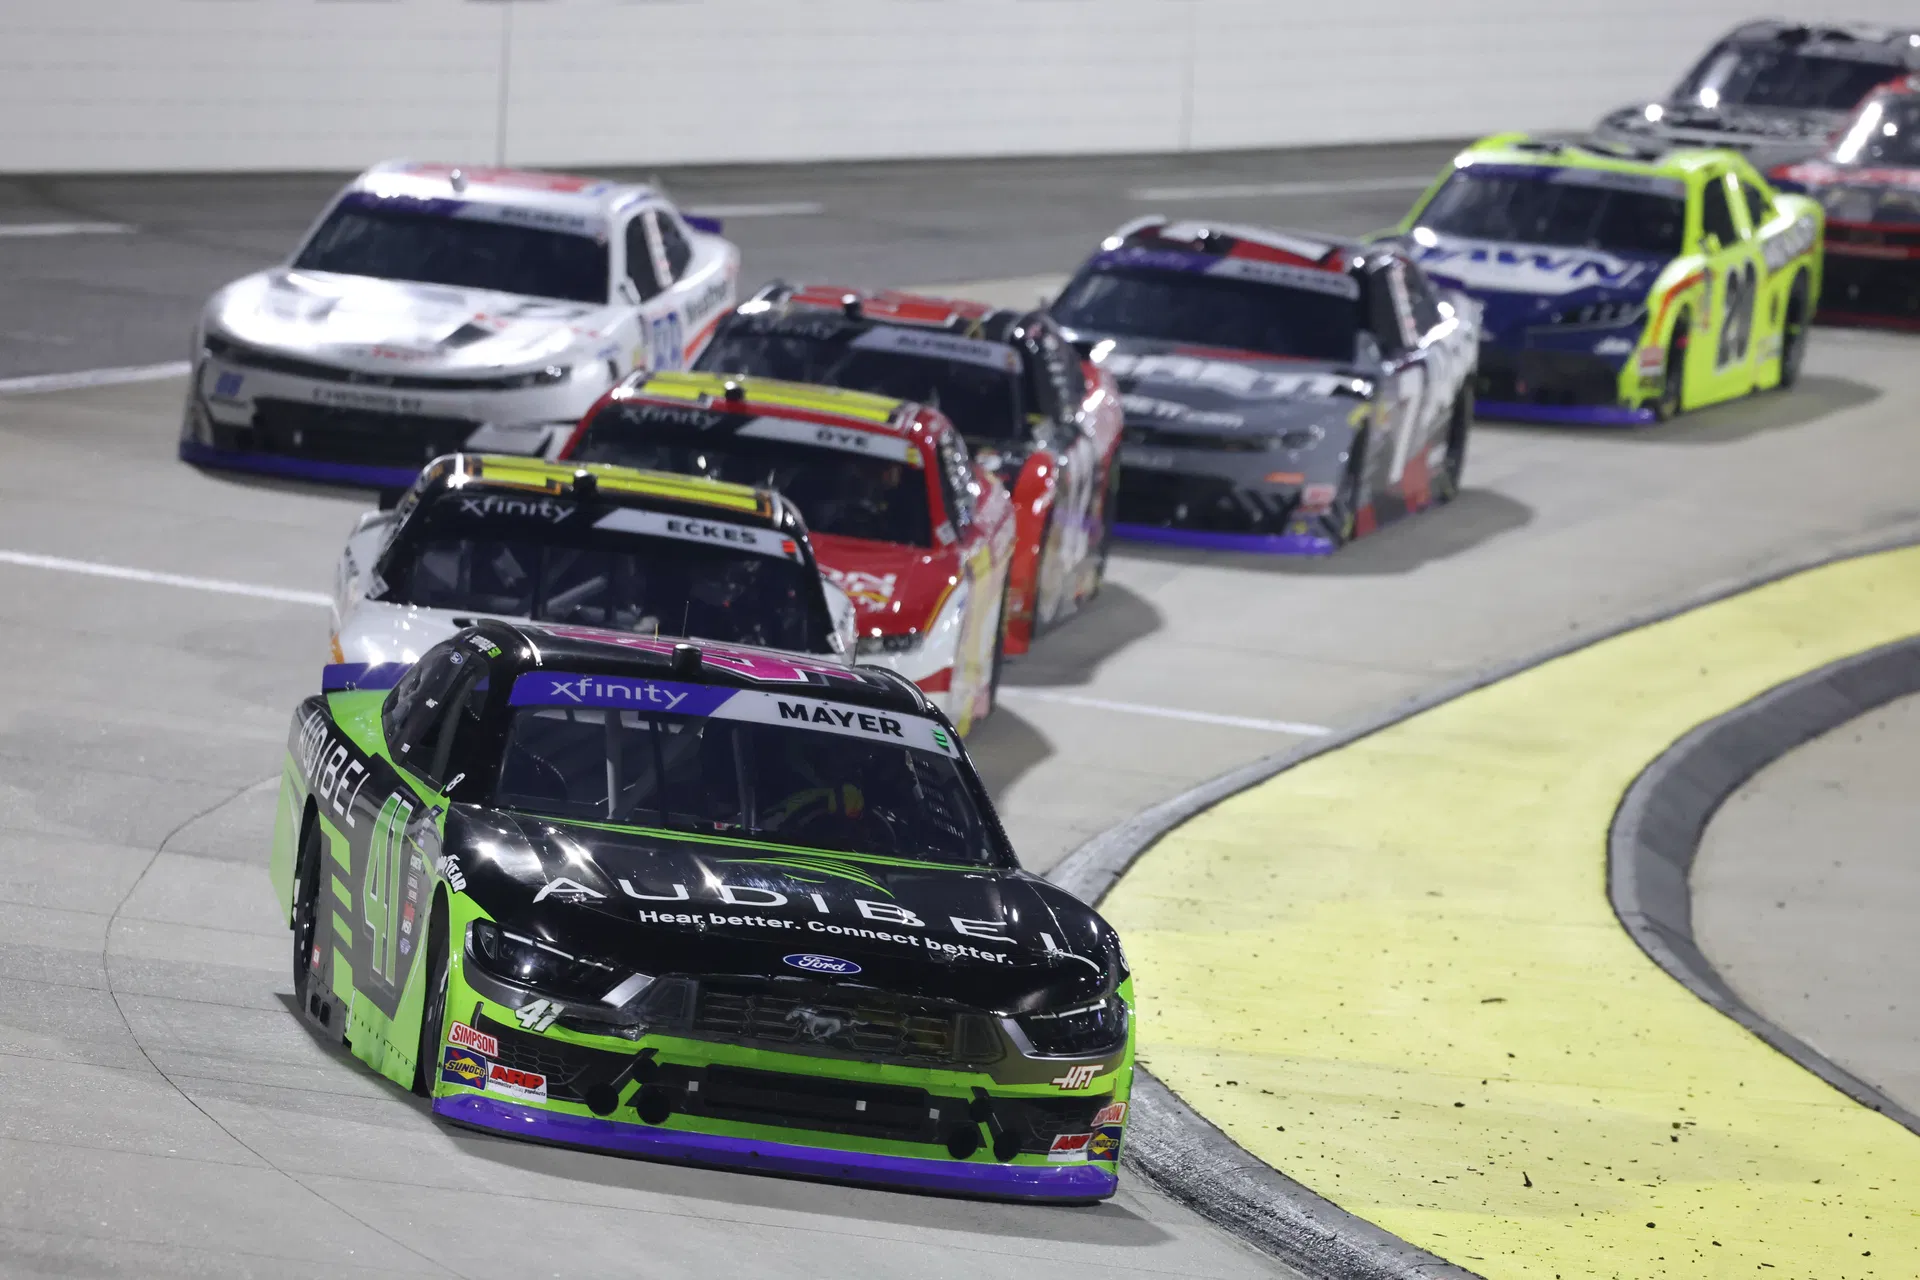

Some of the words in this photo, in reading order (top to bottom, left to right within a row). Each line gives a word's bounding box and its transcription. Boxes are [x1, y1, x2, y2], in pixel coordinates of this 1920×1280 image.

[816, 429, 869, 448] DYE
[460, 495, 575, 524] xfinity
[666, 519, 757, 545] ECKES
[550, 678, 689, 709] xfinity
[777, 701, 904, 738] MAYER
[363, 791, 414, 988] 41
[532, 876, 1101, 974] AUDIBEL
[639, 909, 701, 924] Hear
[710, 912, 802, 931] better.
[808, 920, 920, 947] Connect
[926, 937, 1015, 965] better.
[797, 953, 847, 974] Ford
[514, 998, 567, 1032] 41
[452, 1024, 495, 1055] SIMPSON
[446, 1060, 486, 1078] SUNOCO
[489, 1065, 545, 1090] ARP
[1050, 1064, 1104, 1090] HFT
